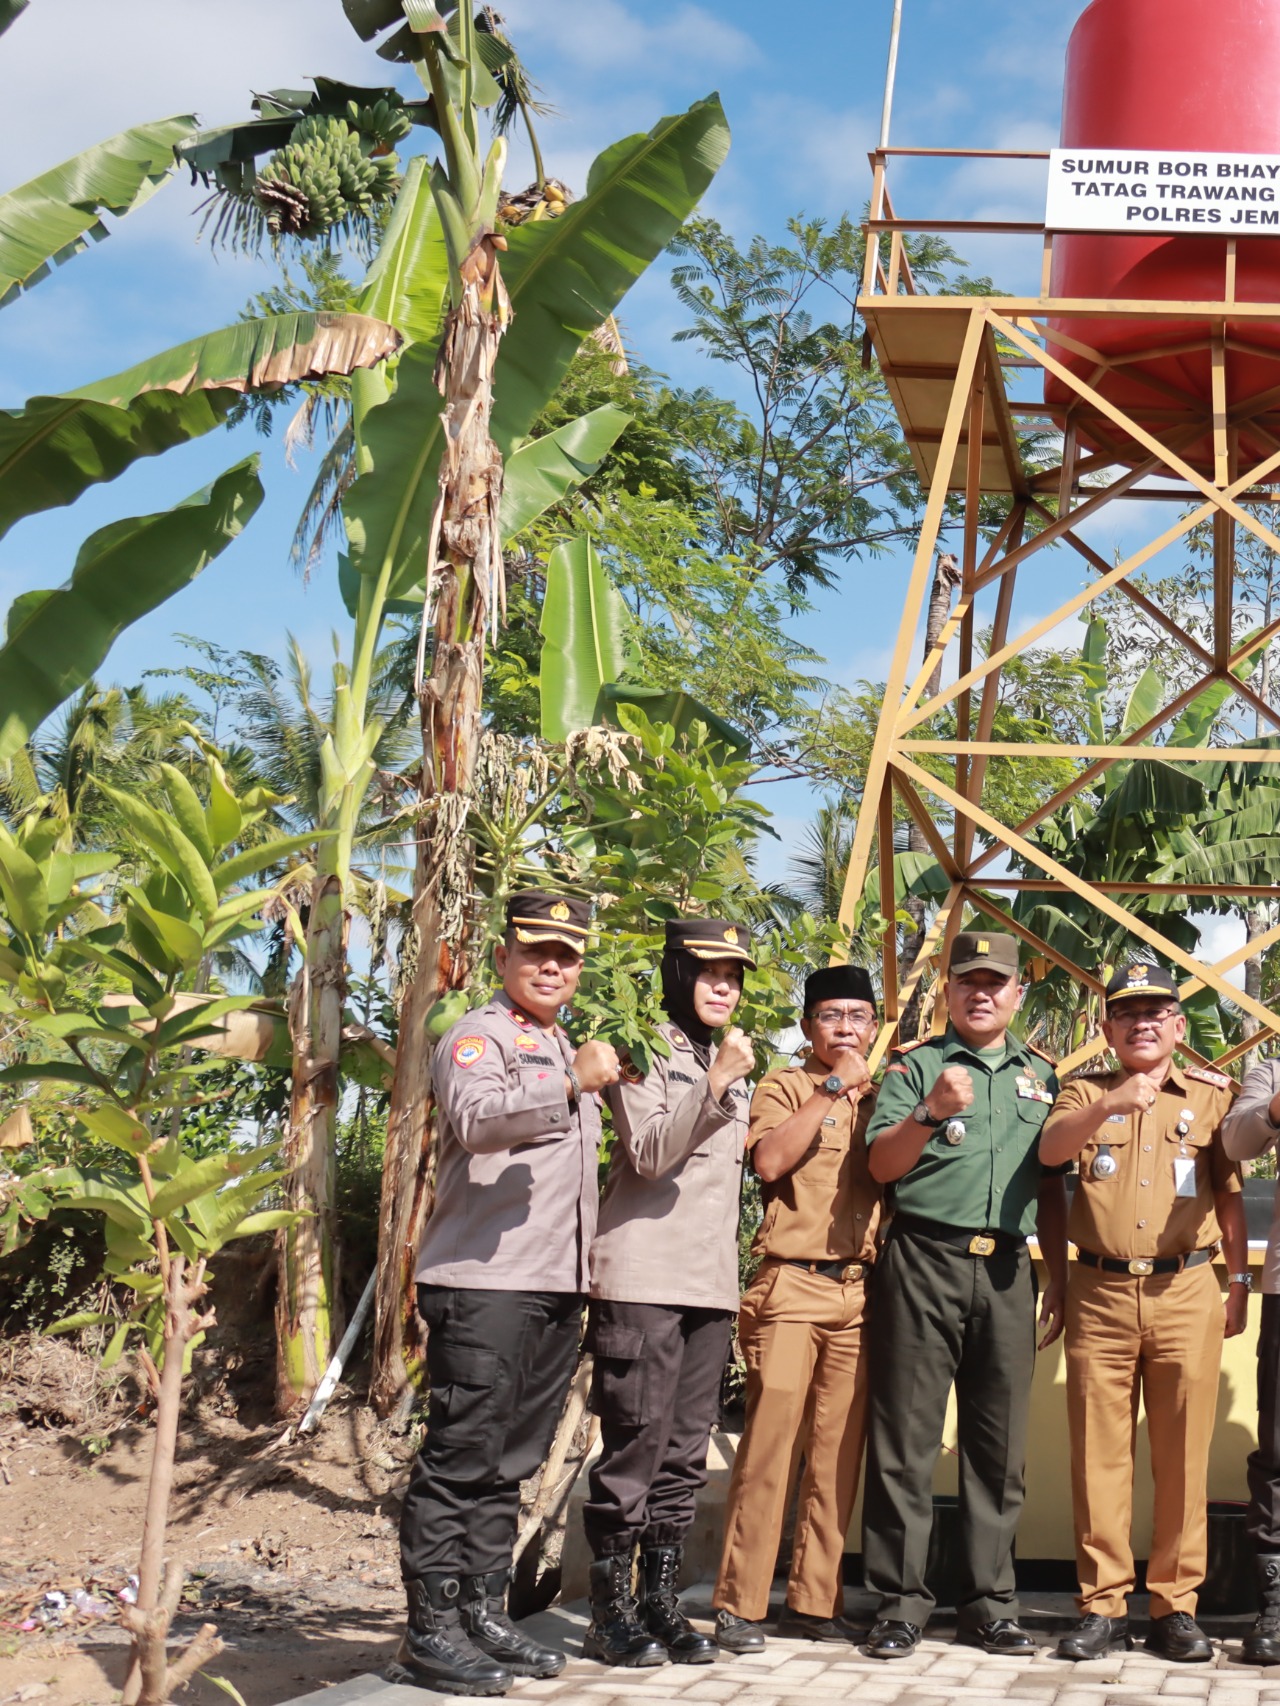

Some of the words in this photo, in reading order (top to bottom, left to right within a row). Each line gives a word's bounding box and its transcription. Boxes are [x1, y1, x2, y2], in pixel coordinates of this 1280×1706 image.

[1061, 158, 1150, 176] SUMUR
[1157, 161, 1208, 178] BOR
[1071, 181, 1148, 198] TATAG
[1155, 184, 1276, 203] TRAWANG
[1126, 205, 1222, 224] POLRES
